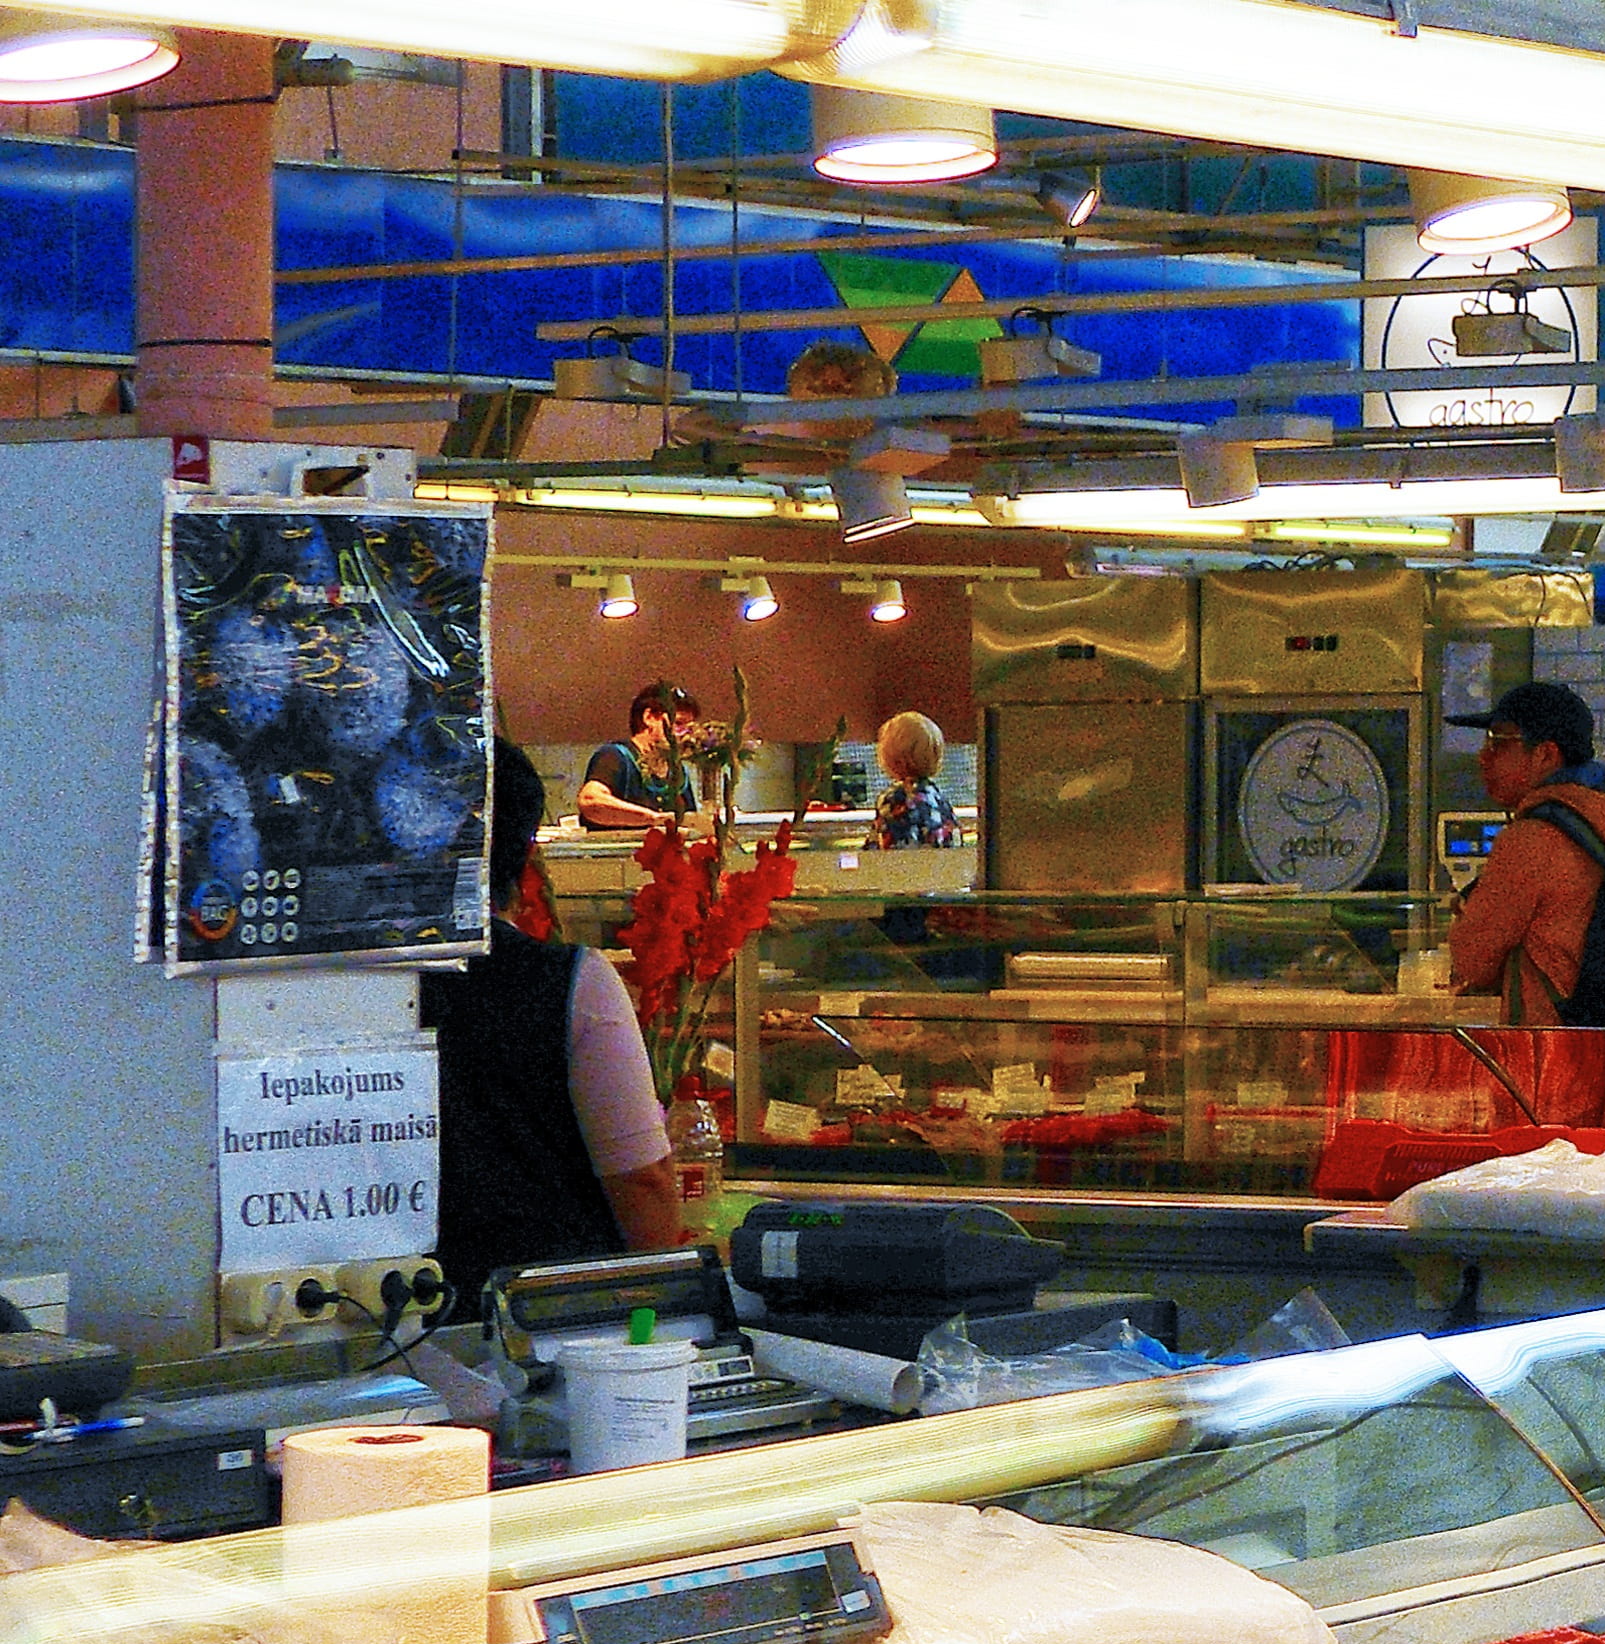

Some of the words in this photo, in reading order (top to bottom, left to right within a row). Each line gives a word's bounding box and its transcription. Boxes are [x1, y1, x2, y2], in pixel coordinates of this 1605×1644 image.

[259, 1066, 405, 1106] Iepakojums
[223, 1117, 362, 1154] hermetiskā
[370, 1112, 438, 1143] maisā
[239, 1189, 335, 1228] CENA
[343, 1181, 400, 1219] 1.00
[408, 1179, 427, 1213] €
